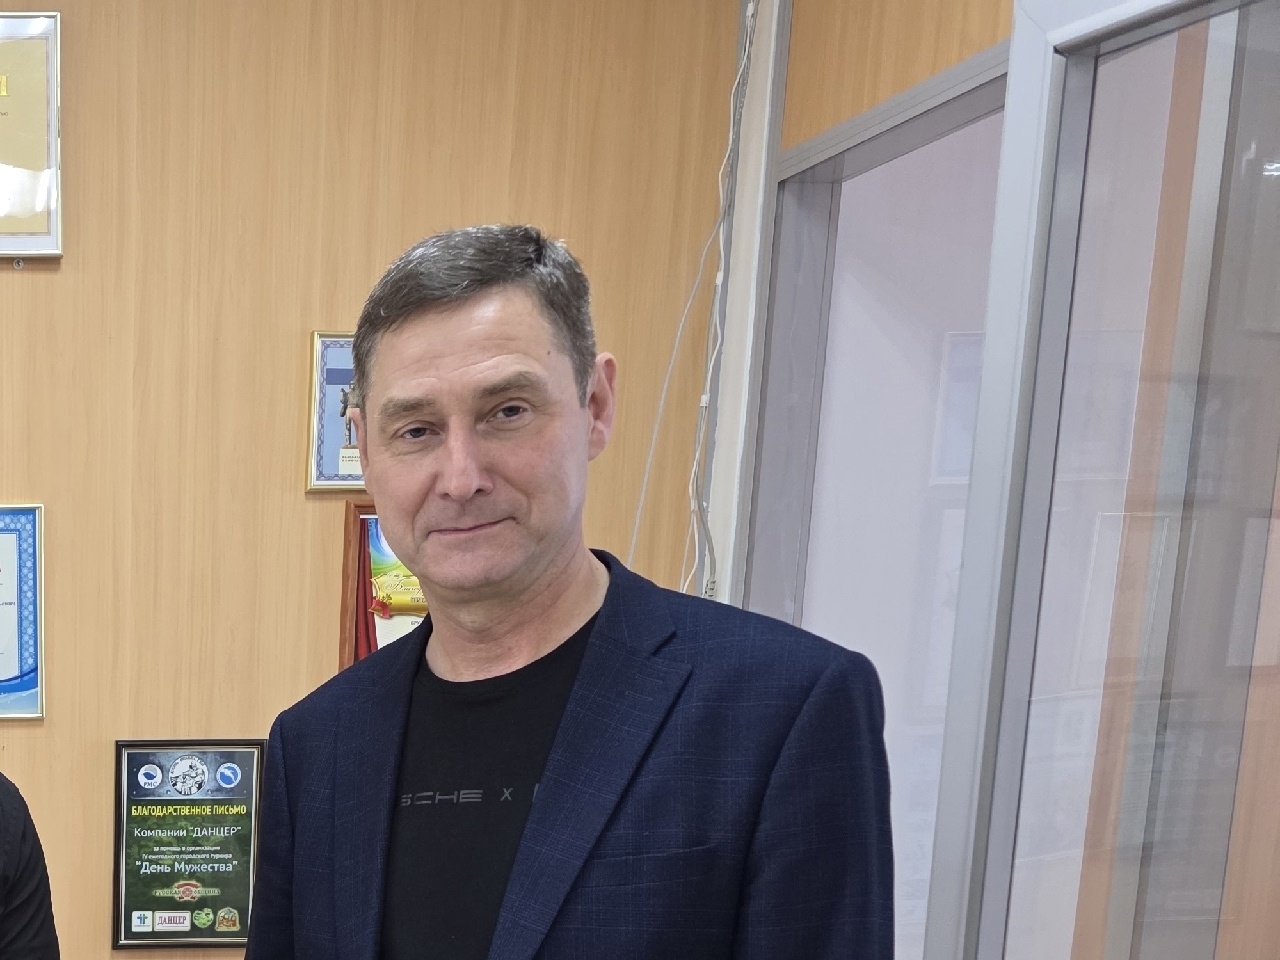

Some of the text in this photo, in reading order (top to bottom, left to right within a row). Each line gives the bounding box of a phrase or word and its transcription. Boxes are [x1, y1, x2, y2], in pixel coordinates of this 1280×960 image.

[131, 804, 247, 817] БЛАГОДАРСТВЕННОЕ ПИСЬМО
[134, 827, 187, 837] Компании
[157, 915, 187, 926] ДАНЦЕР
